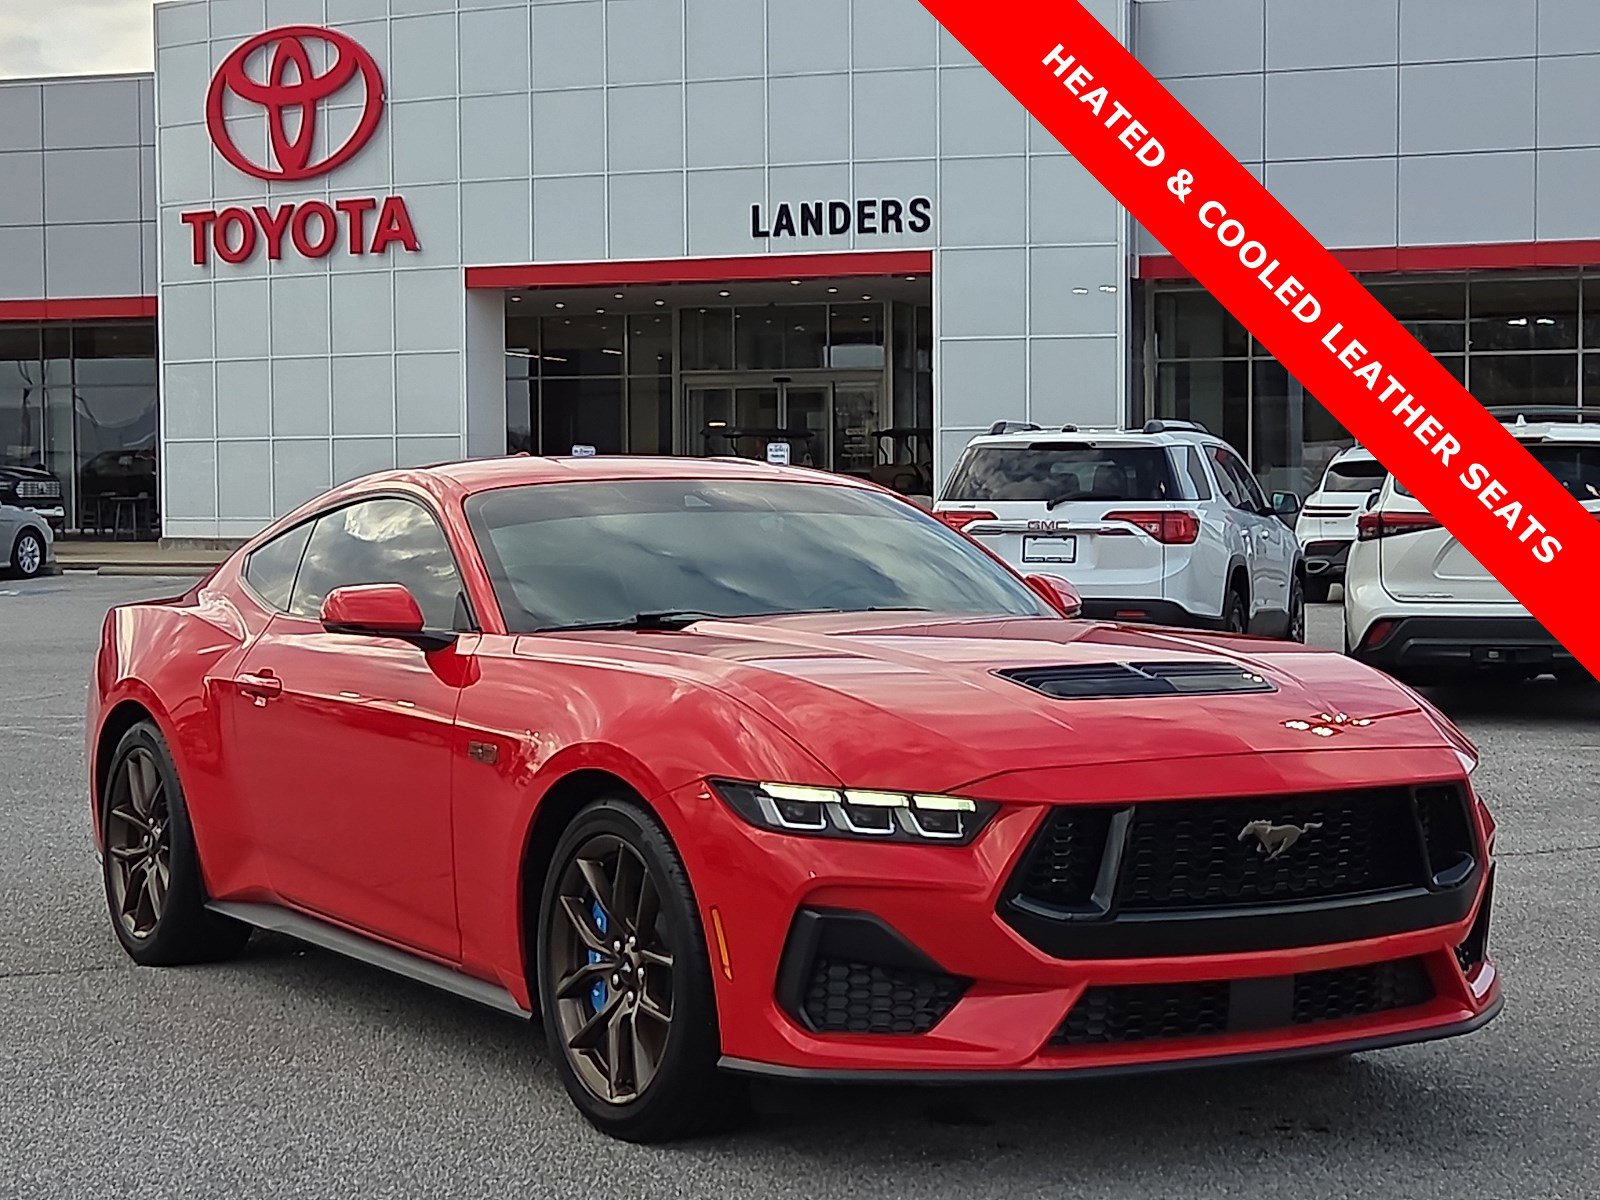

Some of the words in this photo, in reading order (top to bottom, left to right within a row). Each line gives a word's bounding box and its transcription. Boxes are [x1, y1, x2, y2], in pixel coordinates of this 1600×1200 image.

[181, 195, 420, 265] TOYOTA
[751, 197, 932, 238] LANDERS
[1027, 520, 1069, 531] GMC
